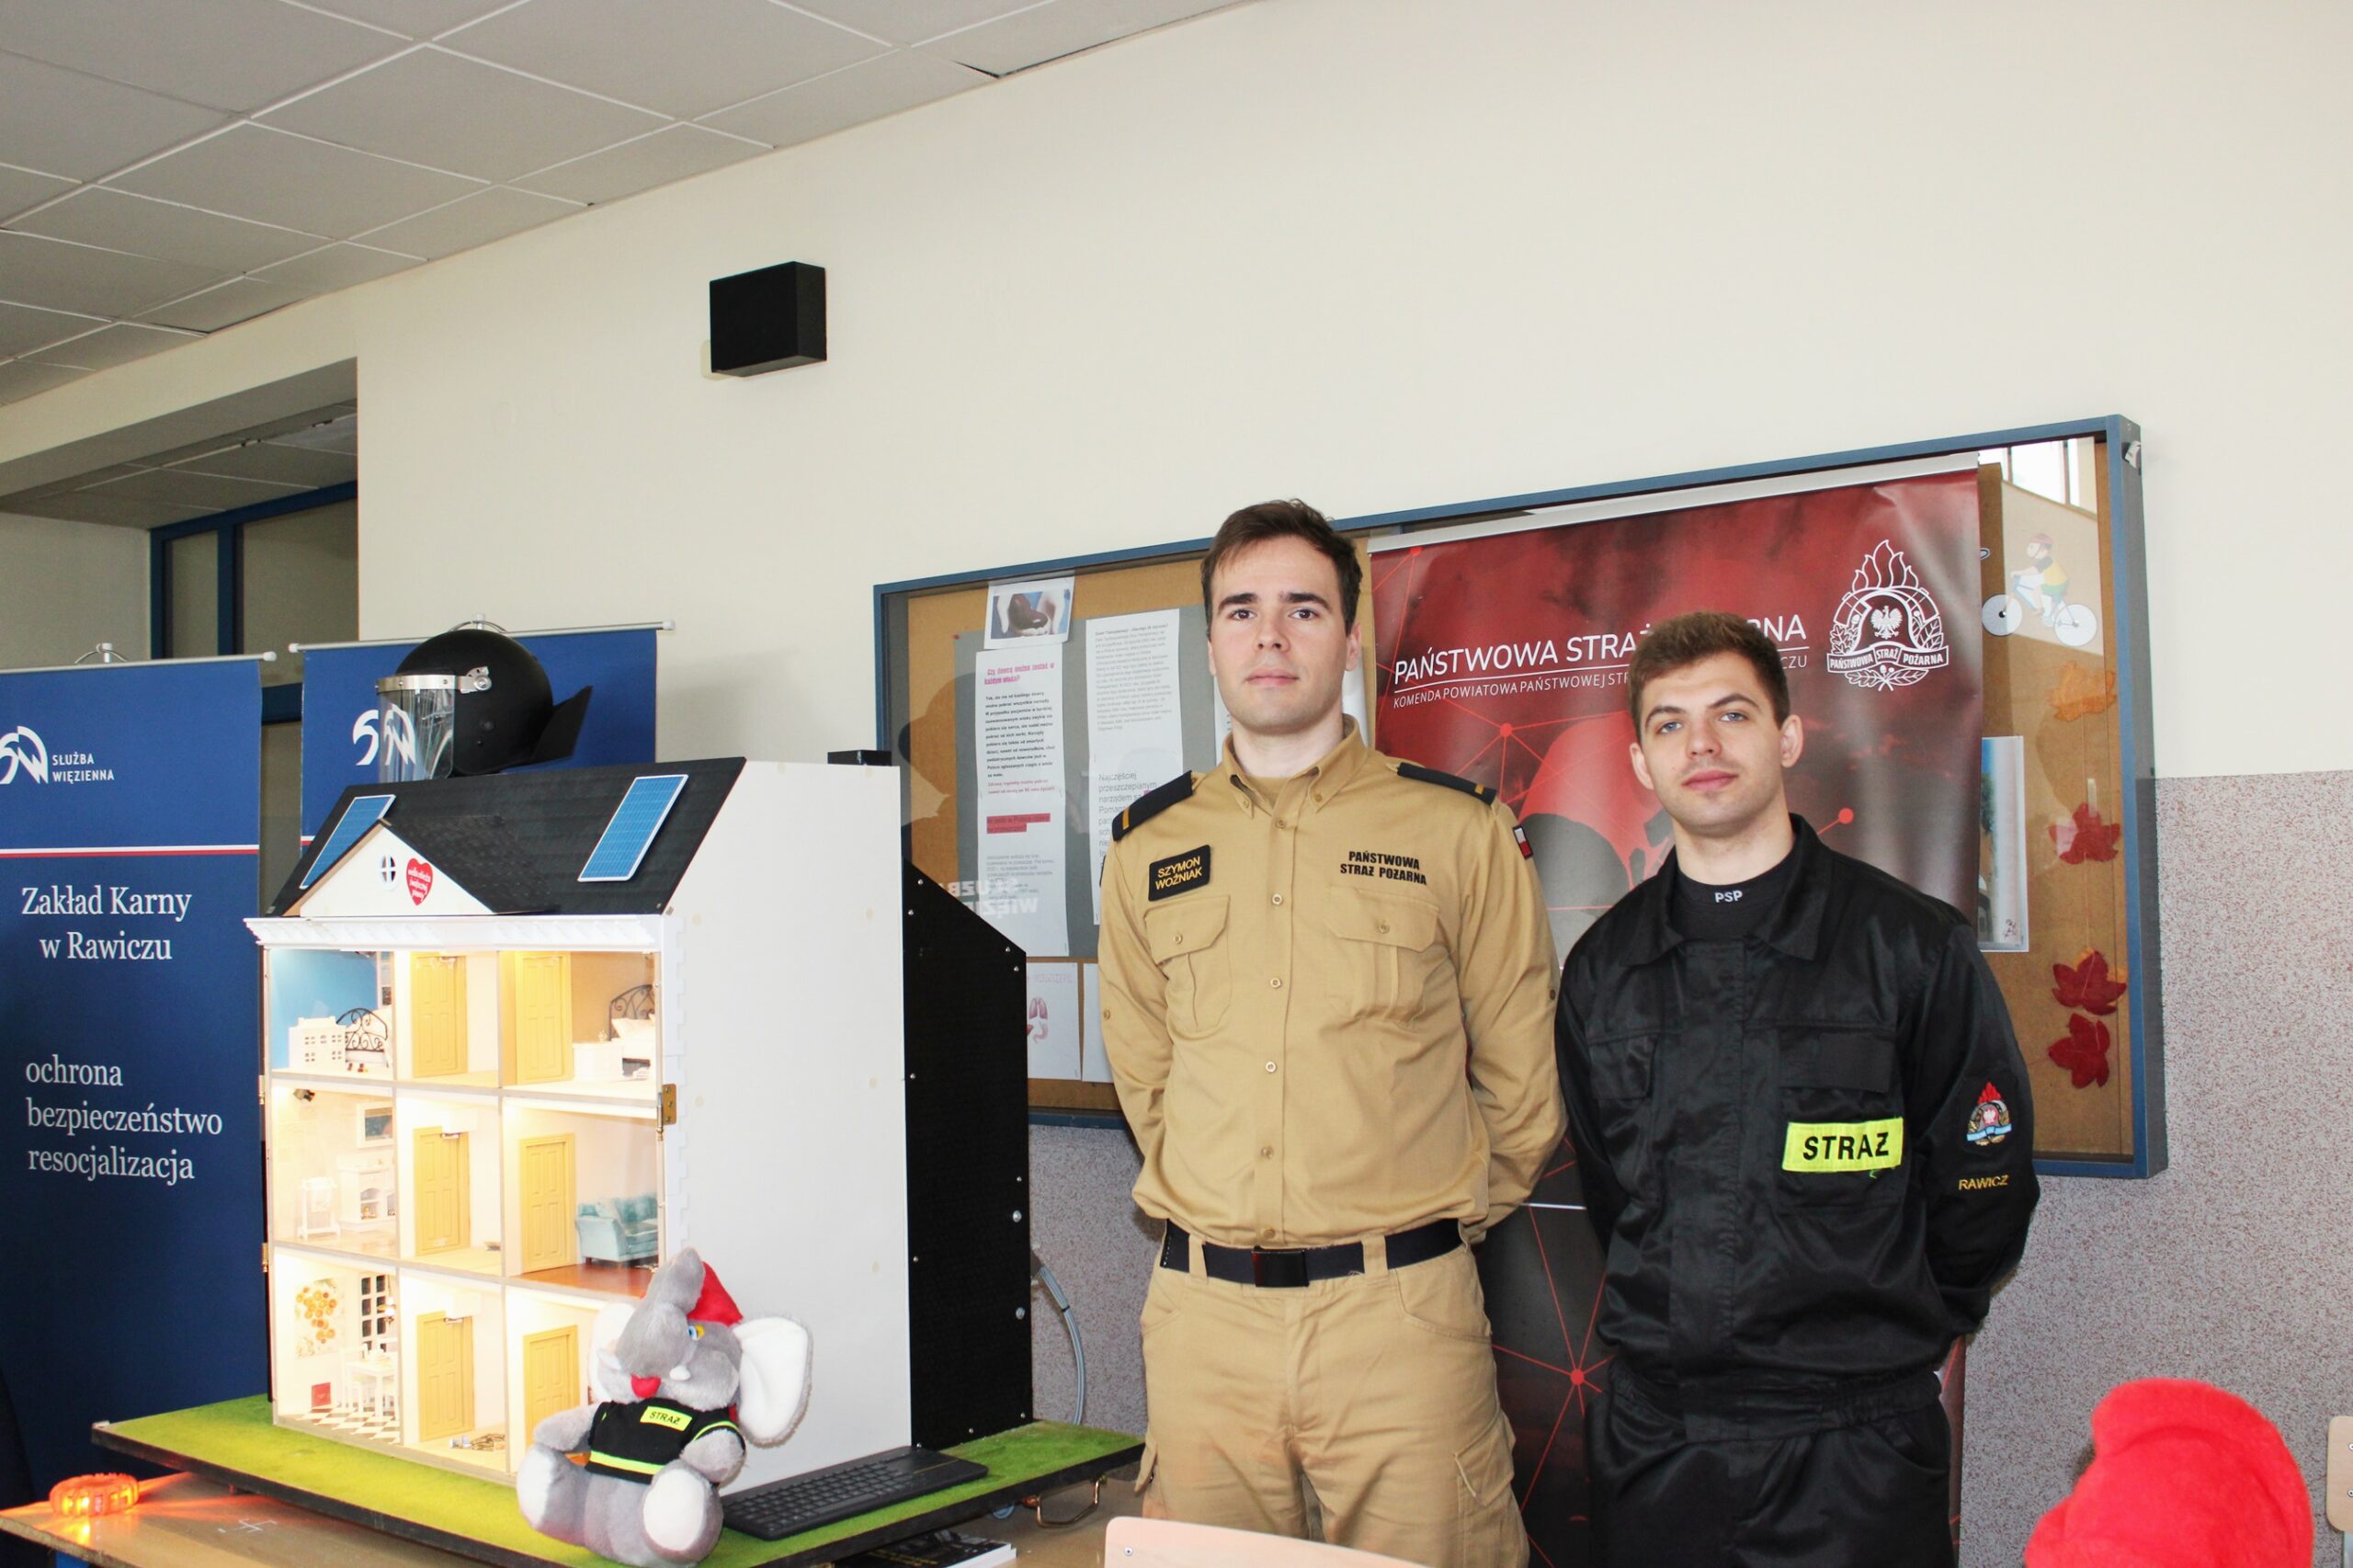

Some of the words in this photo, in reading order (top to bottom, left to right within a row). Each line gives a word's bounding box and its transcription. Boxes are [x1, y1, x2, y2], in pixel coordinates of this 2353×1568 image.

[1394, 640, 1558, 685] PAŃSTWOWA
[1566, 623, 1650, 662] STRA
[1829, 653, 1873, 669] PAŃSTWOWA
[1903, 653, 1943, 665] POŻARNA
[1393, 690, 1441, 709] KOMENDA
[1443, 684, 1517, 699] POWIATOWA
[1519, 673, 1605, 693] PAŃSTWOWEJ
[52, 751, 95, 766] SŁUŻBA
[52, 769, 115, 784] WIĘZIENNA
[1158, 856, 1200, 878] SZYMON
[1348, 850, 1420, 870] PAŃSTWOWA
[21, 884, 103, 915] Zakład
[109, 887, 192, 922] Karny
[1714, 890, 1743, 903] PSP
[40, 938, 62, 959] w
[66, 930, 173, 960] Rawiczu
[25, 1053, 123, 1086] ochrona
[26, 1096, 223, 1136] bezpieczeństwo
[28, 1144, 195, 1186] resocjalizacja
[1958, 1175, 2009, 1190] RAWICZ
